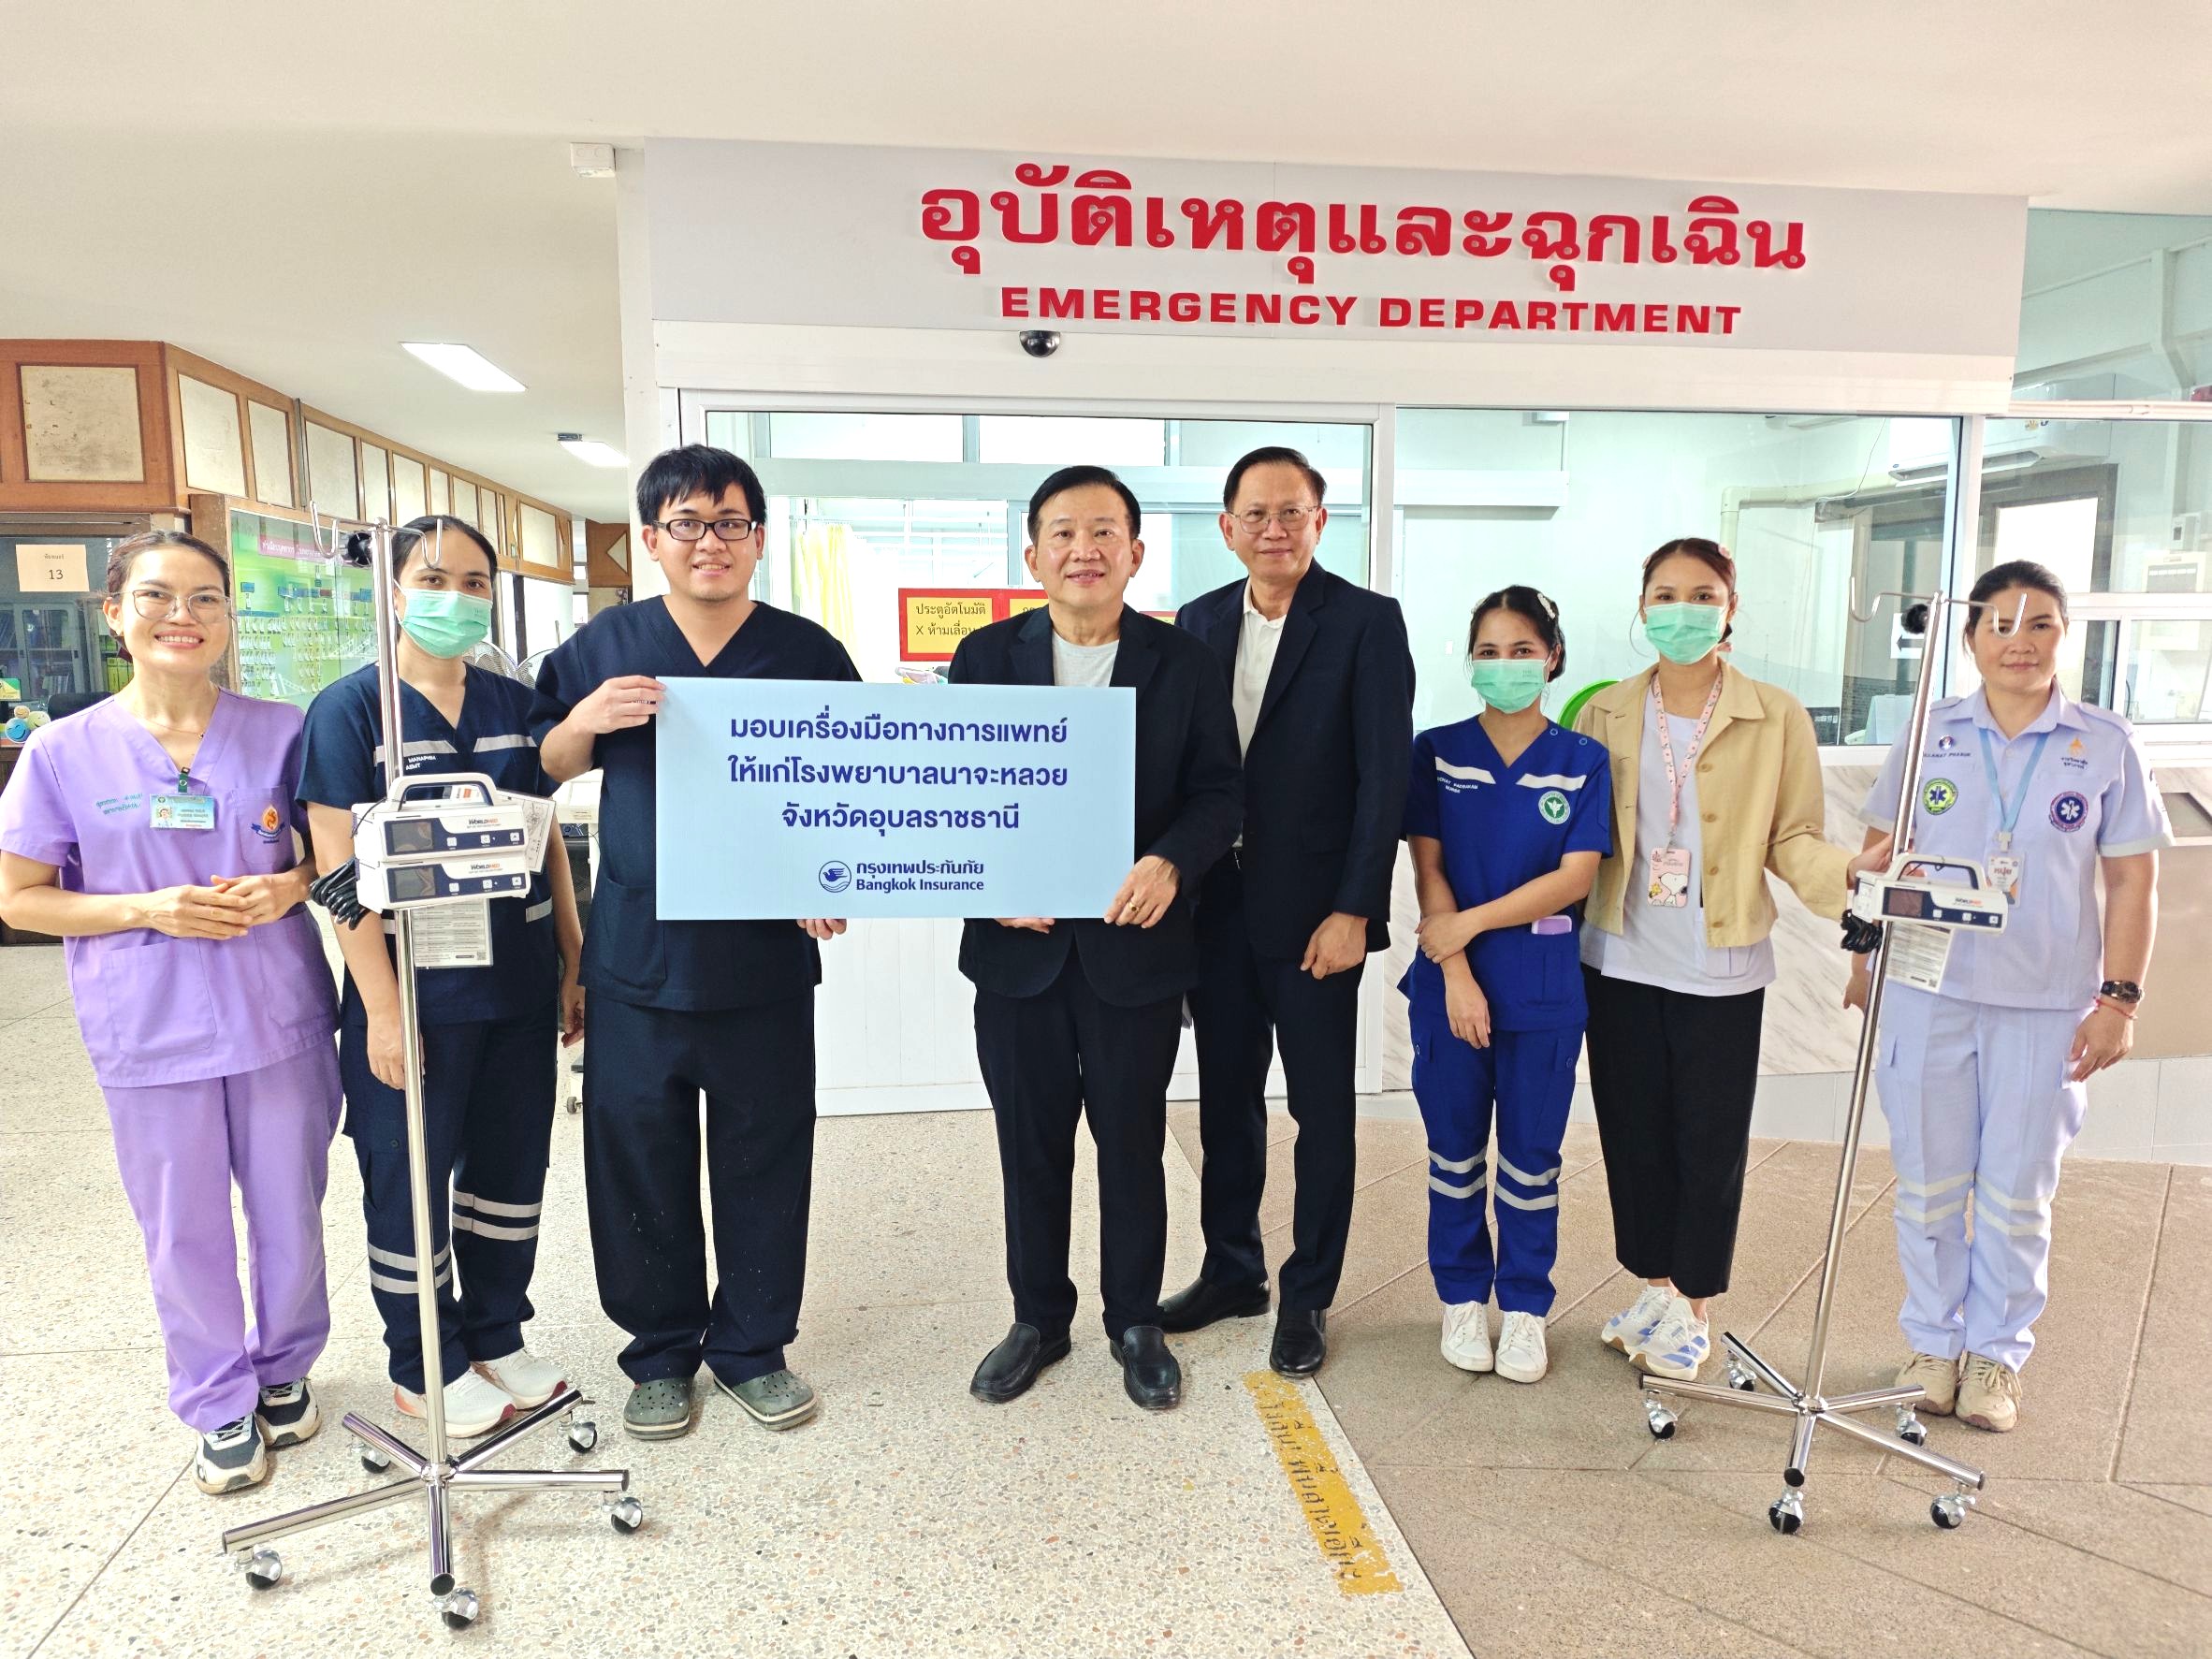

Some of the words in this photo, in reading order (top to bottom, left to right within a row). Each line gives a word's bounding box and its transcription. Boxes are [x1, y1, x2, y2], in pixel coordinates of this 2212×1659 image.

[921, 163, 1807, 292] อุบัติเหตุและฉุกเฉิน
[1001, 286, 1358, 327] EMERGENCY
[1379, 298, 1742, 335] DEPARTMENT
[49, 569, 64, 580] 13
[915, 601, 986, 619] ประตูอัตโนมัติ
[915, 625, 924, 635] X
[730, 705, 1069, 744] มอบเครื่องมือทางการแพทย์
[727, 754, 1069, 787] ให้แก่โรงพยาบาลนาจะหลวย
[781, 801, 1020, 837] จังหวัดอุบลราชธานี
[856, 859, 984, 879] กรุงเทพประกันภัย
[856, 878, 916, 894] Bangkok
[920, 879, 984, 890] Insurance
